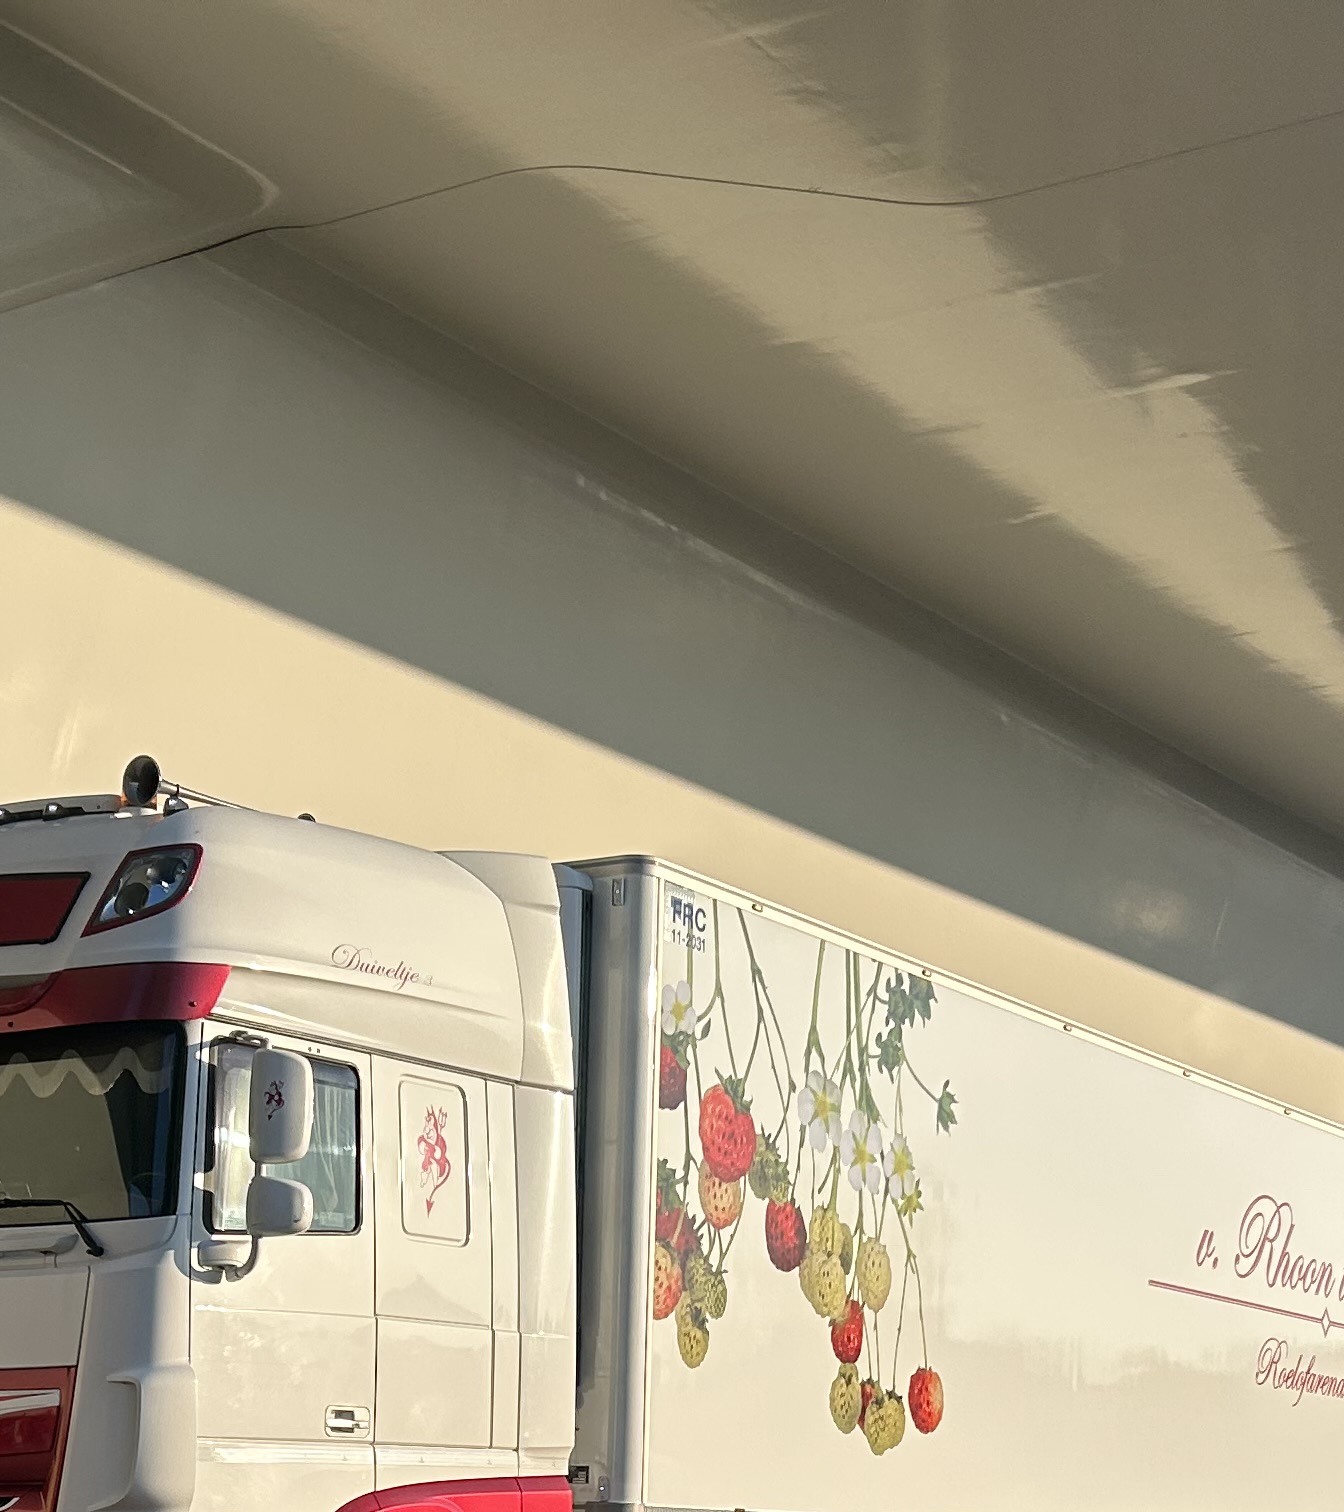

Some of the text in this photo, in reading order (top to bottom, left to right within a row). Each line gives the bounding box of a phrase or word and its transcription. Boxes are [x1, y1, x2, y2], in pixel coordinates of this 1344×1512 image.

[671, 928, 706, 953] 11-2031
[331, 943, 420, 991] Duiveltje
[1195, 1229, 1219, 1269] v.
[1234, 1194, 1336, 1298] Rhoon
